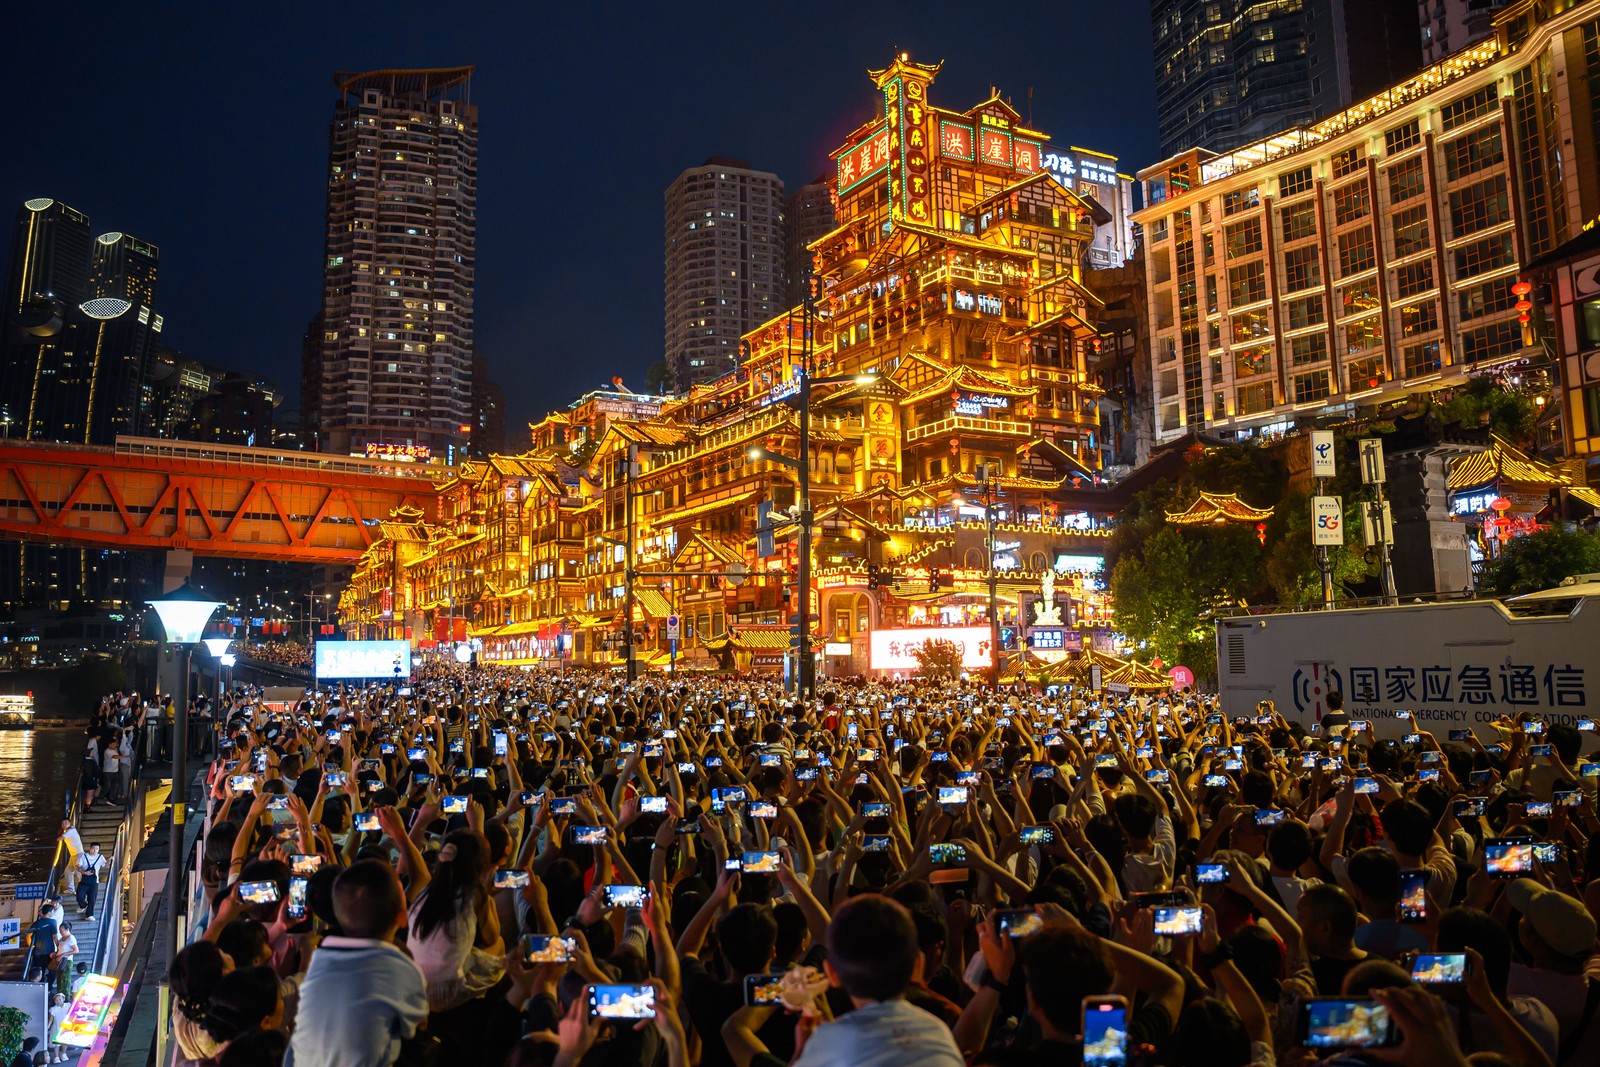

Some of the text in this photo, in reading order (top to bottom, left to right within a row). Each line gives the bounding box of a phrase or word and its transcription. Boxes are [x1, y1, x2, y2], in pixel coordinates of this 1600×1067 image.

[840, 135, 890, 187] 洪崖洞
[946, 132, 1033, 171] 洪崖洞
[1318, 514, 1339, 530] 5G
[1349, 664, 1586, 707] 国家应急通信
[1352, 708, 1397, 719] NATIONA
[1410, 709, 1467, 721] MERGENCY
